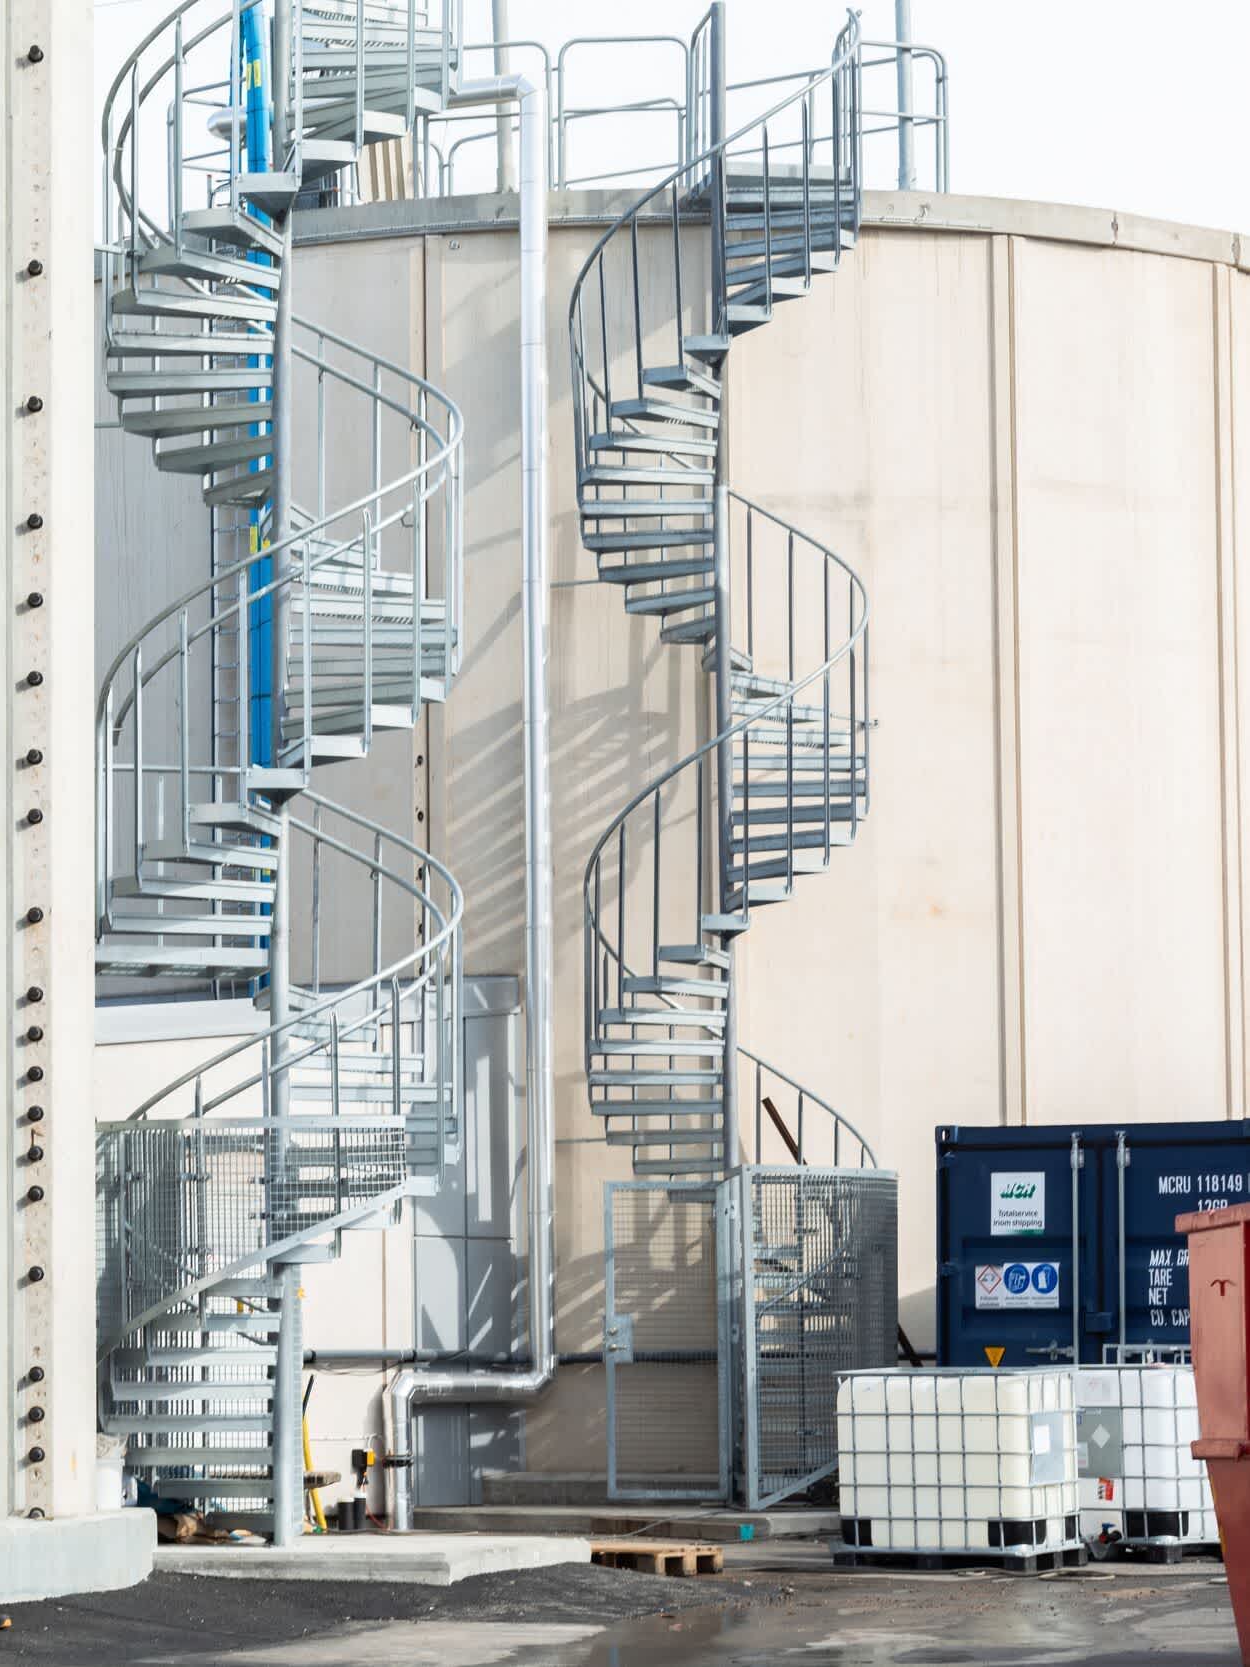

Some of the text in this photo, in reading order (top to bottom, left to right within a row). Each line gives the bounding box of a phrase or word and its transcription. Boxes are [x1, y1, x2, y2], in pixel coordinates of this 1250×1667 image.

[1158, 1174, 1243, 1194] MCRU 118149
[998, 1209, 1038, 1218] Totalservice
[1012, 1219, 1043, 1228] shipping
[1149, 1249, 1174, 1267] MAX.
[1148, 1268, 1173, 1287] TARE
[1148, 1287, 1168, 1306] NET
[1150, 1308, 1168, 1326] CU.
